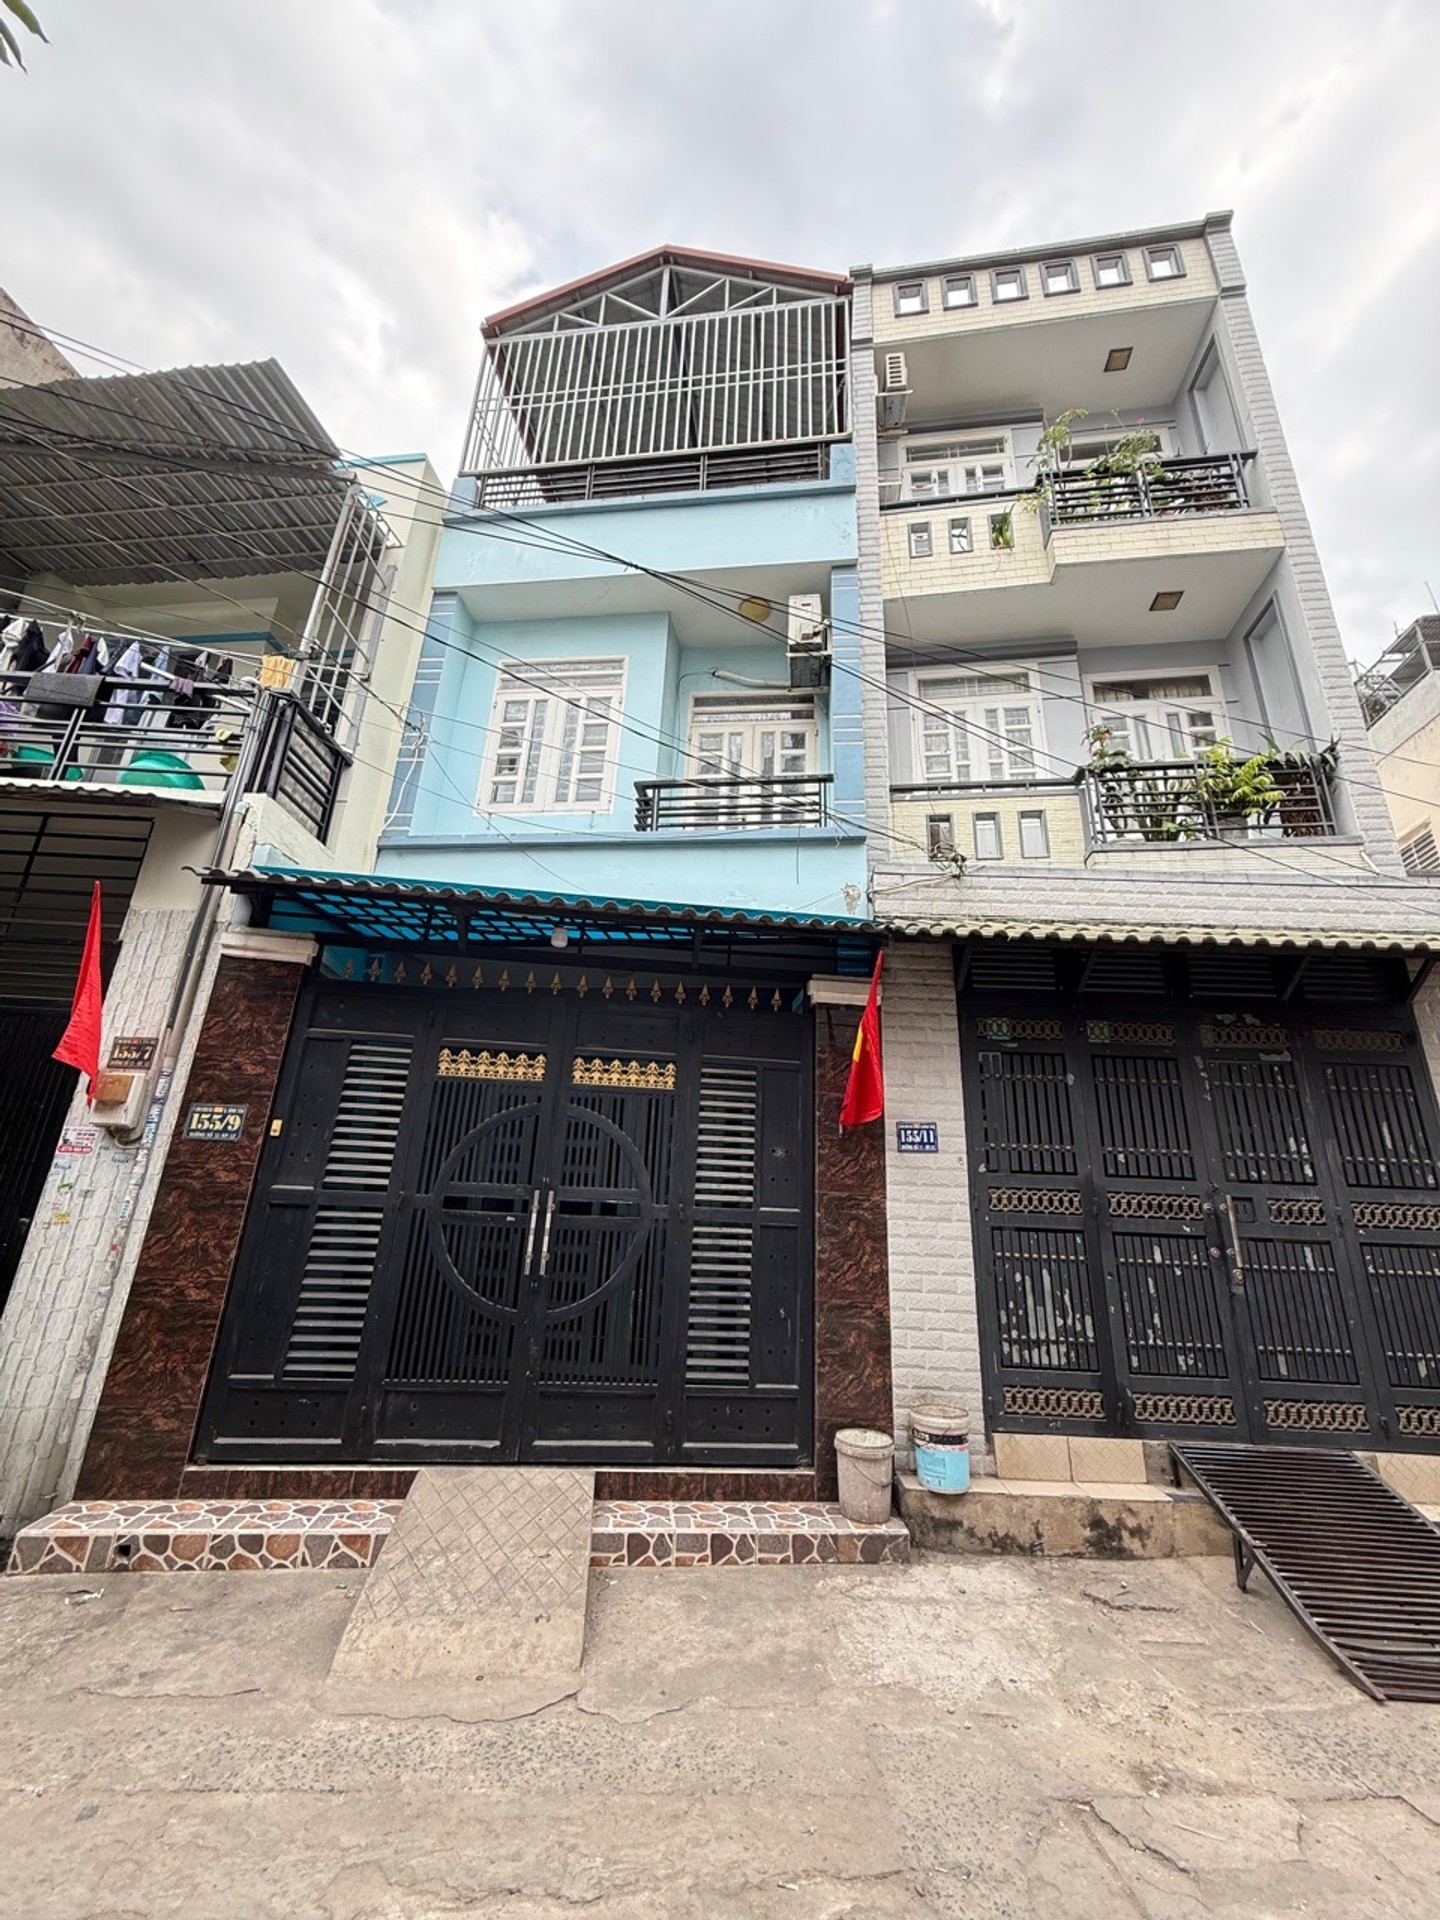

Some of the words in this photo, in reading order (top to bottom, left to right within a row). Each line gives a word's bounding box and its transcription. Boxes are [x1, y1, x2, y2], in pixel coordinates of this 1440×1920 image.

[112, 1045, 153, 1060] 155/7
[189, 1113, 241, 1131] 155/9
[901, 1130, 935, 1142] 155/11
